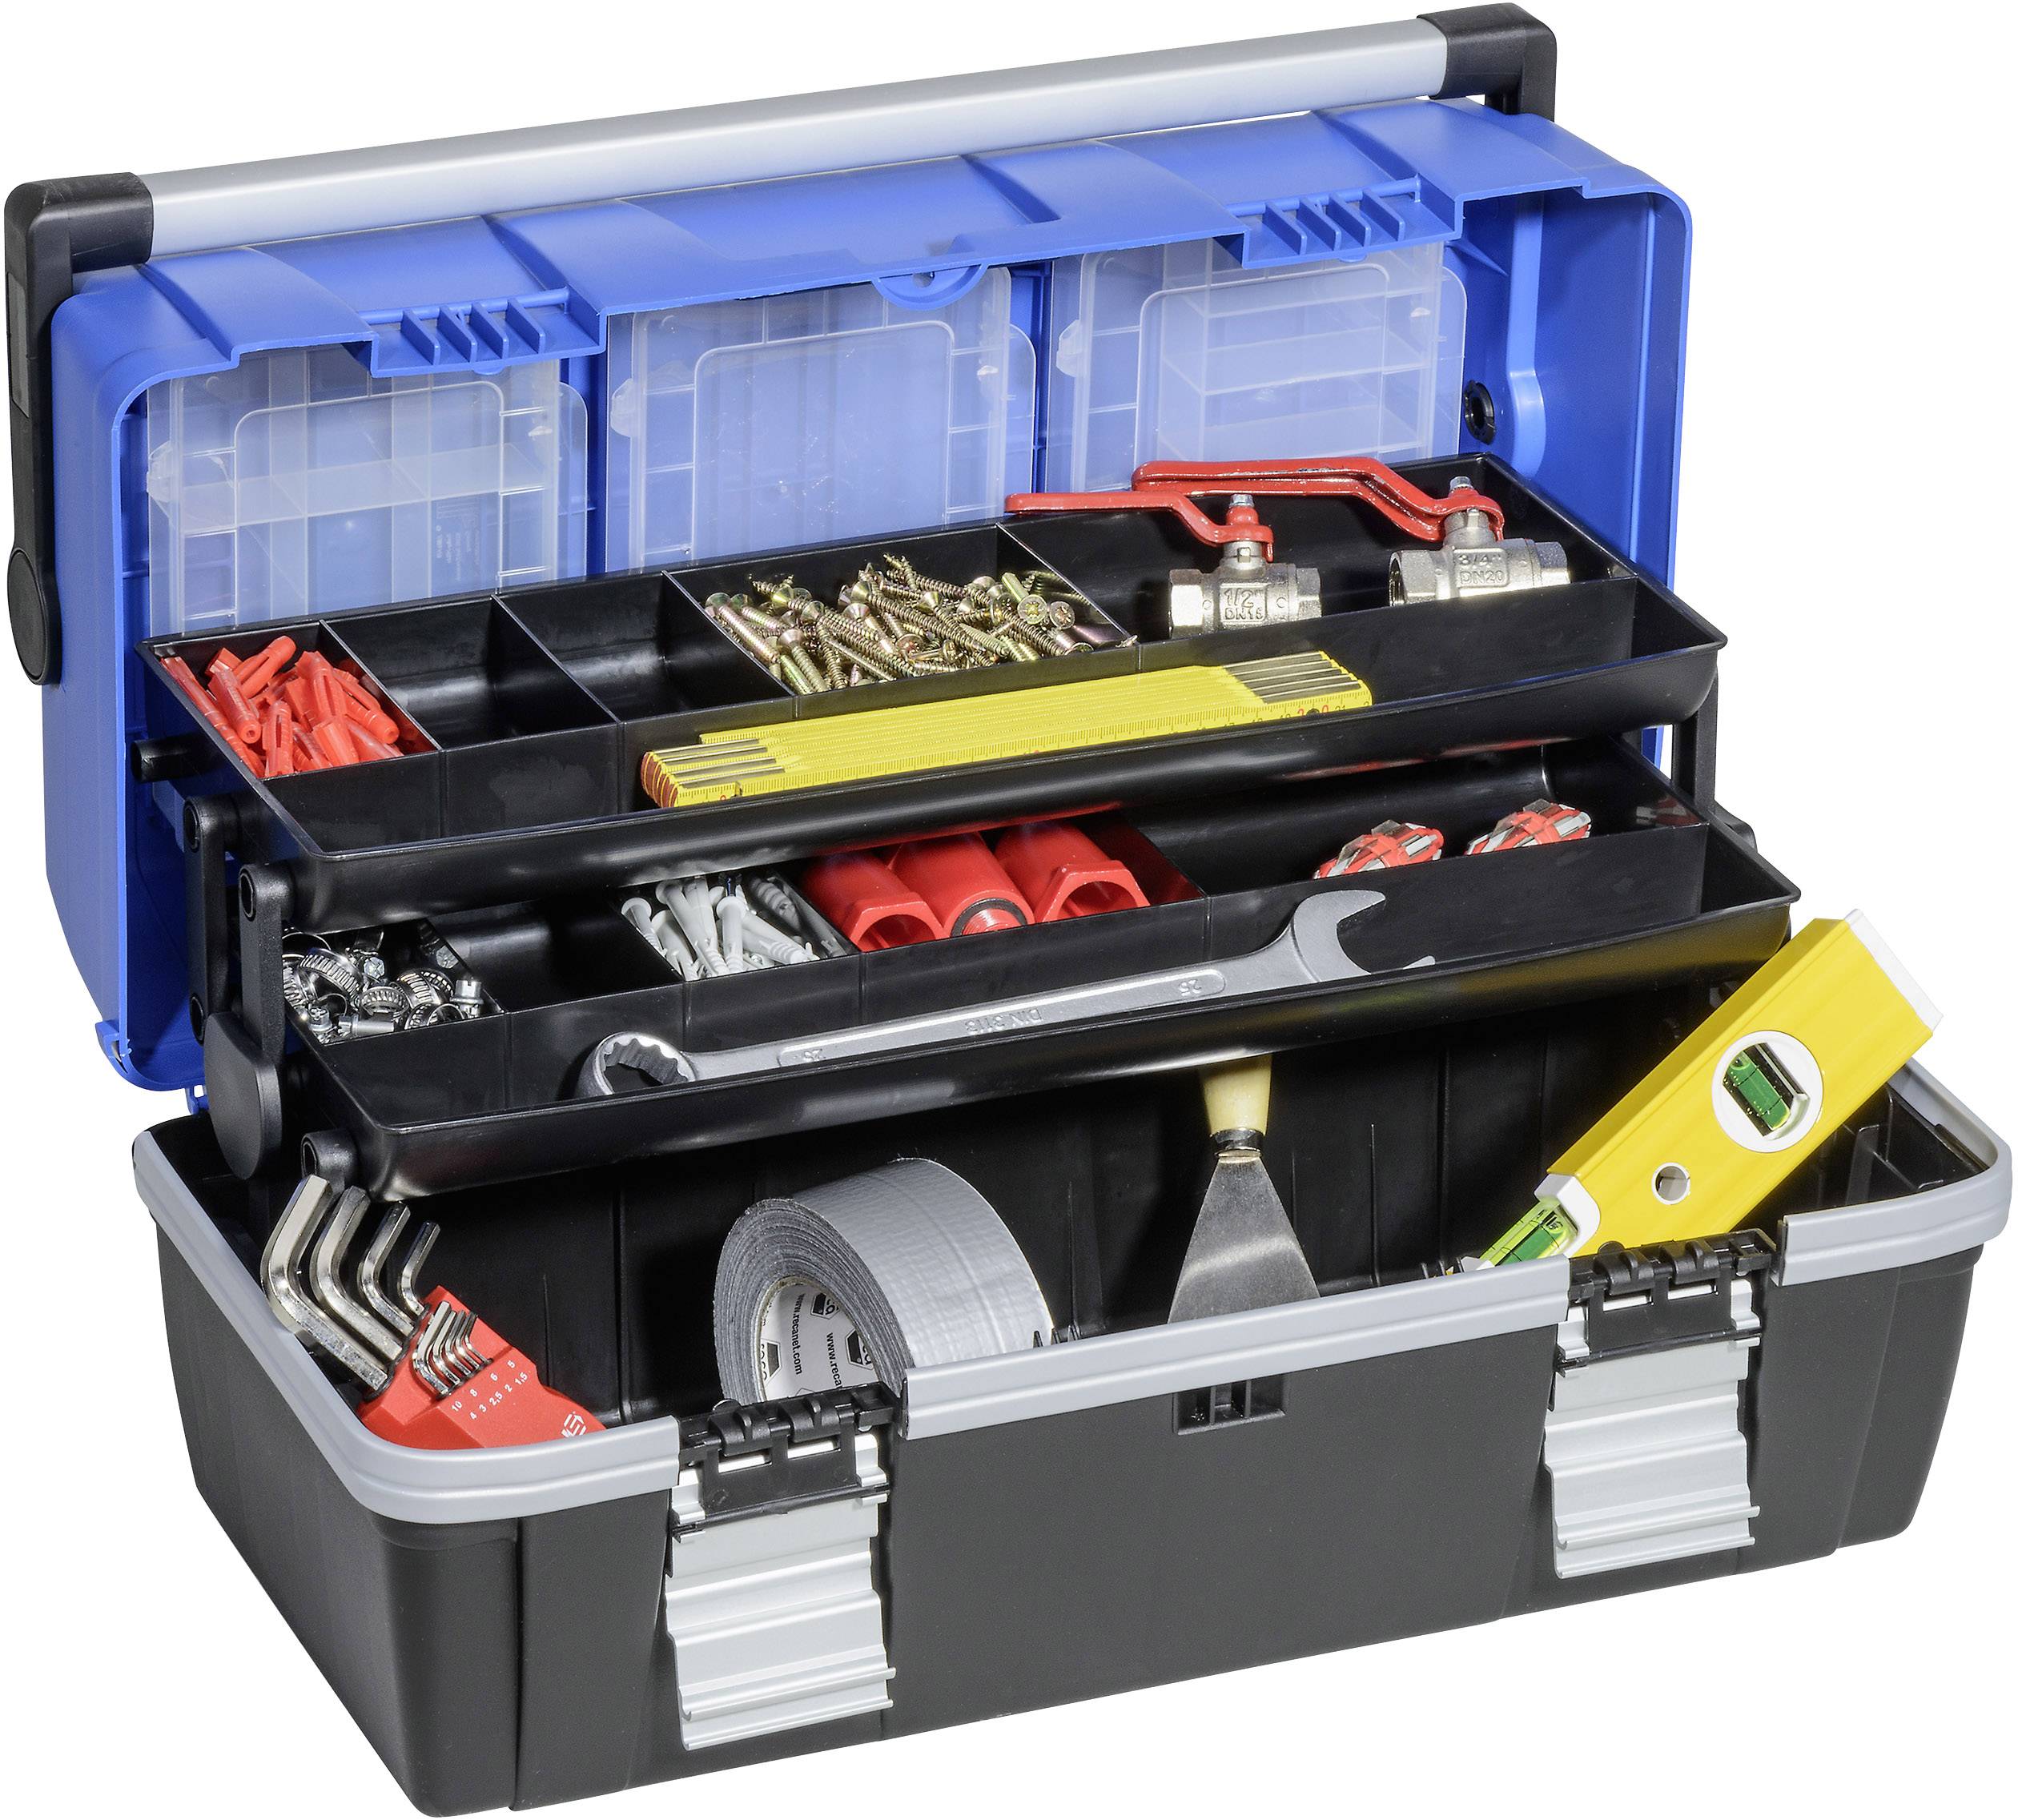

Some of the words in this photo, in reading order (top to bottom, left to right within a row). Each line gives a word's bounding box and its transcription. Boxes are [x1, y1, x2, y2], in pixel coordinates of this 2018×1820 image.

[1460, 569, 1504, 585] DN20
[1224, 607, 1263, 621] DN15
[1178, 978, 1202, 996] 25
[1010, 1007, 1043, 1027] DIN
[790, 1293, 806, 1376] www.recanet.com
[451, 1400, 463, 1412] 10
[469, 1388, 478, 1397] 8
[489, 1372, 498, 1381] 6
[507, 1360, 516, 1368] 5
[469, 1411, 477, 1420] 4
[479, 1404, 487, 1412] 3
[488, 1391, 503, 1406] 2,5
[504, 1384, 513, 1392] 2
[514, 1372, 529, 1385] 1,5
